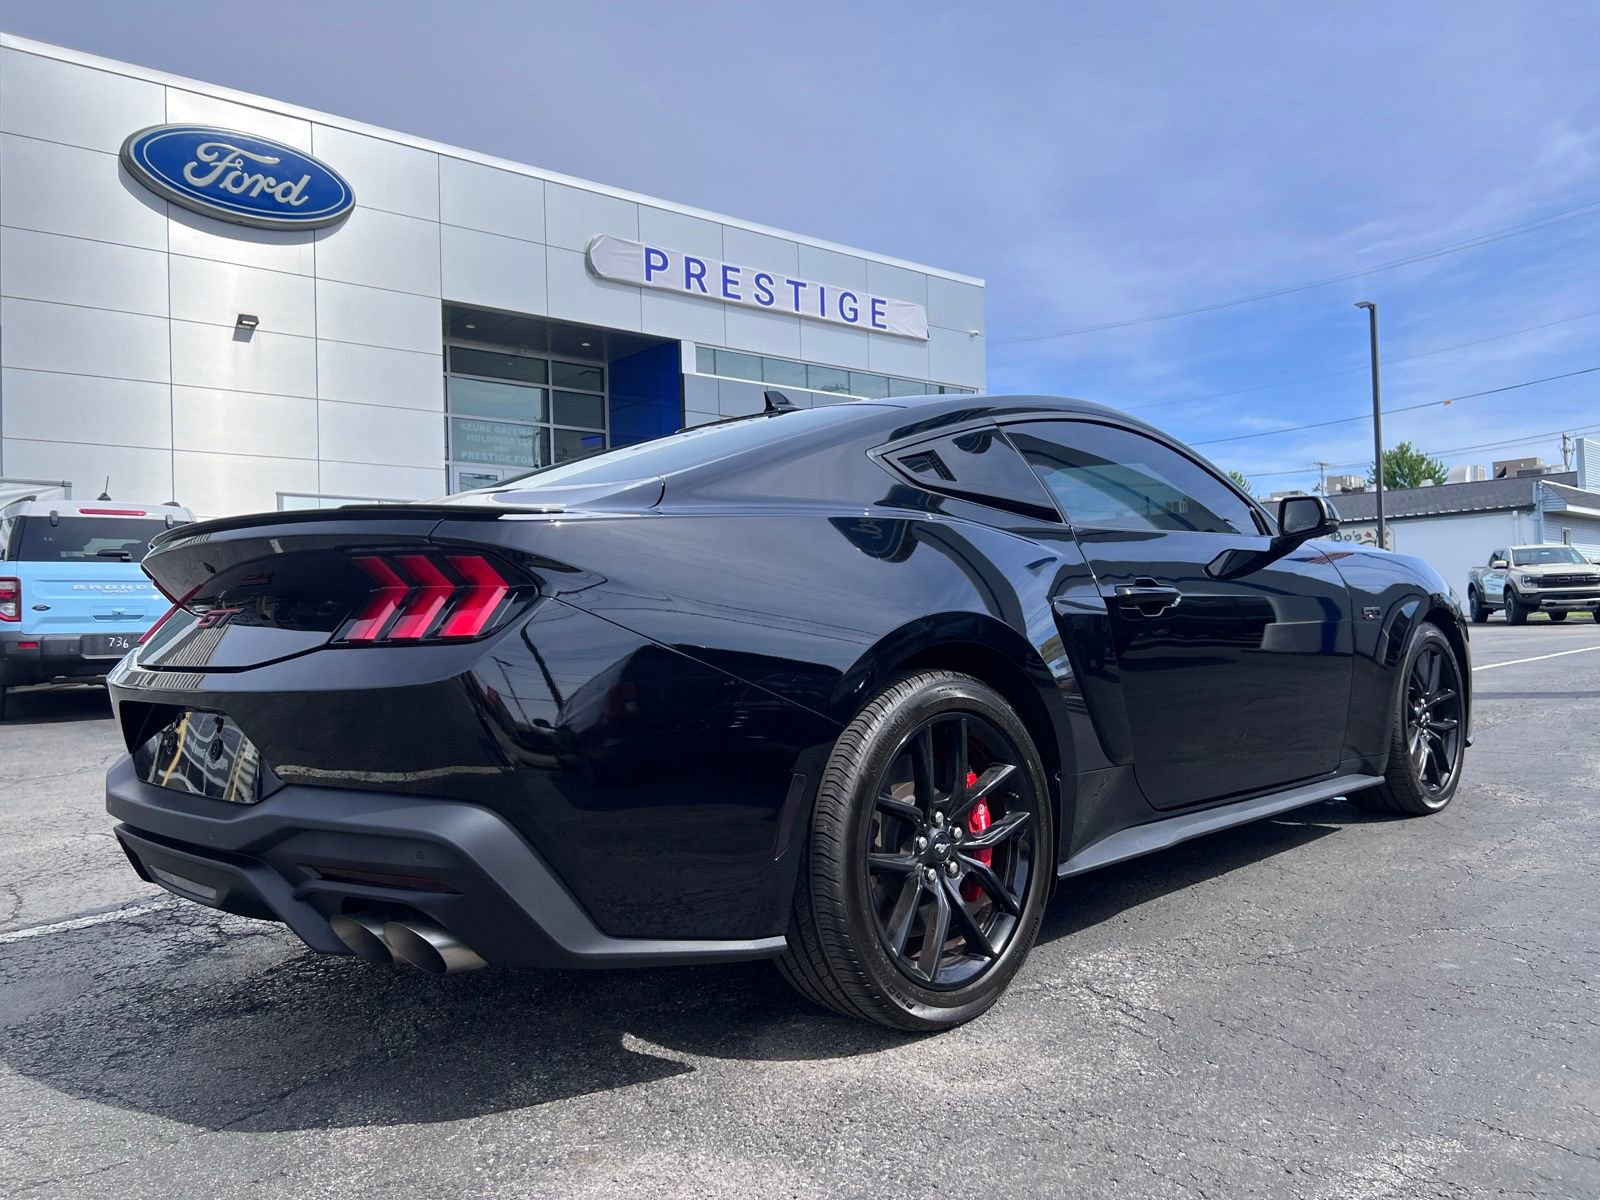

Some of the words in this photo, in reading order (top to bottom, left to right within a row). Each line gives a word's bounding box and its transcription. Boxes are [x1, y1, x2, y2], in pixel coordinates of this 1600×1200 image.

[183, 142, 312, 206] Ford
[644, 246, 889, 330] PRESTIGE
[461, 422, 492, 433] AZURE
[460, 451, 512, 463] PRESTIGE
[197, 608, 247, 629] GT
[108, 637, 130, 649] 736
